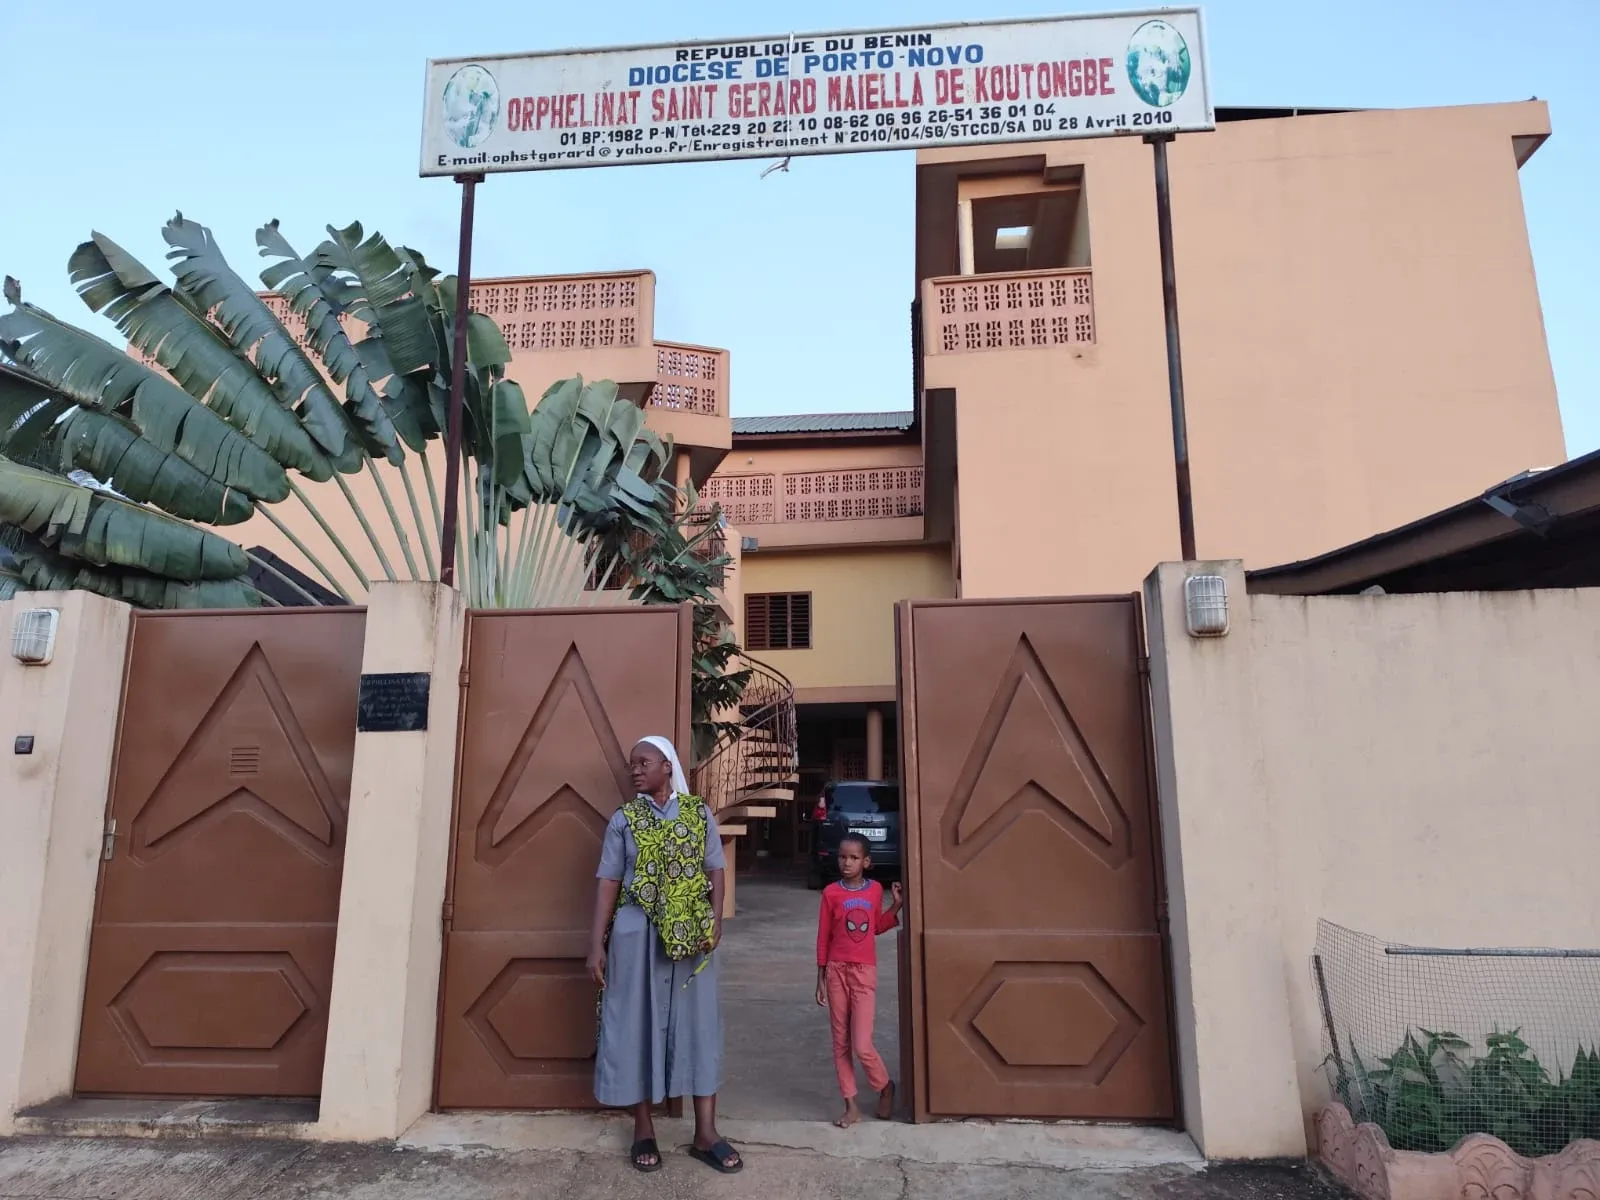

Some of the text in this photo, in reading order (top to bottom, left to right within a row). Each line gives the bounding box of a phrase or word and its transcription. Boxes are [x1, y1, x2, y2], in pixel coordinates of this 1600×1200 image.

[676, 33, 932, 61] REPUBLIQUE DU BENIN
[629, 60, 743, 86] DIOCESE
[756, 57, 790, 78] DE
[508, 57, 1116, 131] ORPHELINAT SAINT GERARD MAIELLA DE KOUTONGBE
[560, 132, 576, 146] 01
[747, 121, 766, 134] 20
[773, 120, 792, 133] 22
[799, 118, 817, 131] 10
[875, 113, 895, 126] 06
[901, 111, 922, 125] 96
[980, 106, 1001, 120] 36
[1008, 104, 1027, 118] 01
[1034, 103, 1056, 116] 04
[1033, 119, 1051, 132] DU
[1058, 117, 1078, 130] 28
[1085, 114, 1126, 129] Avril
[1132, 111, 1173, 126] 2010
